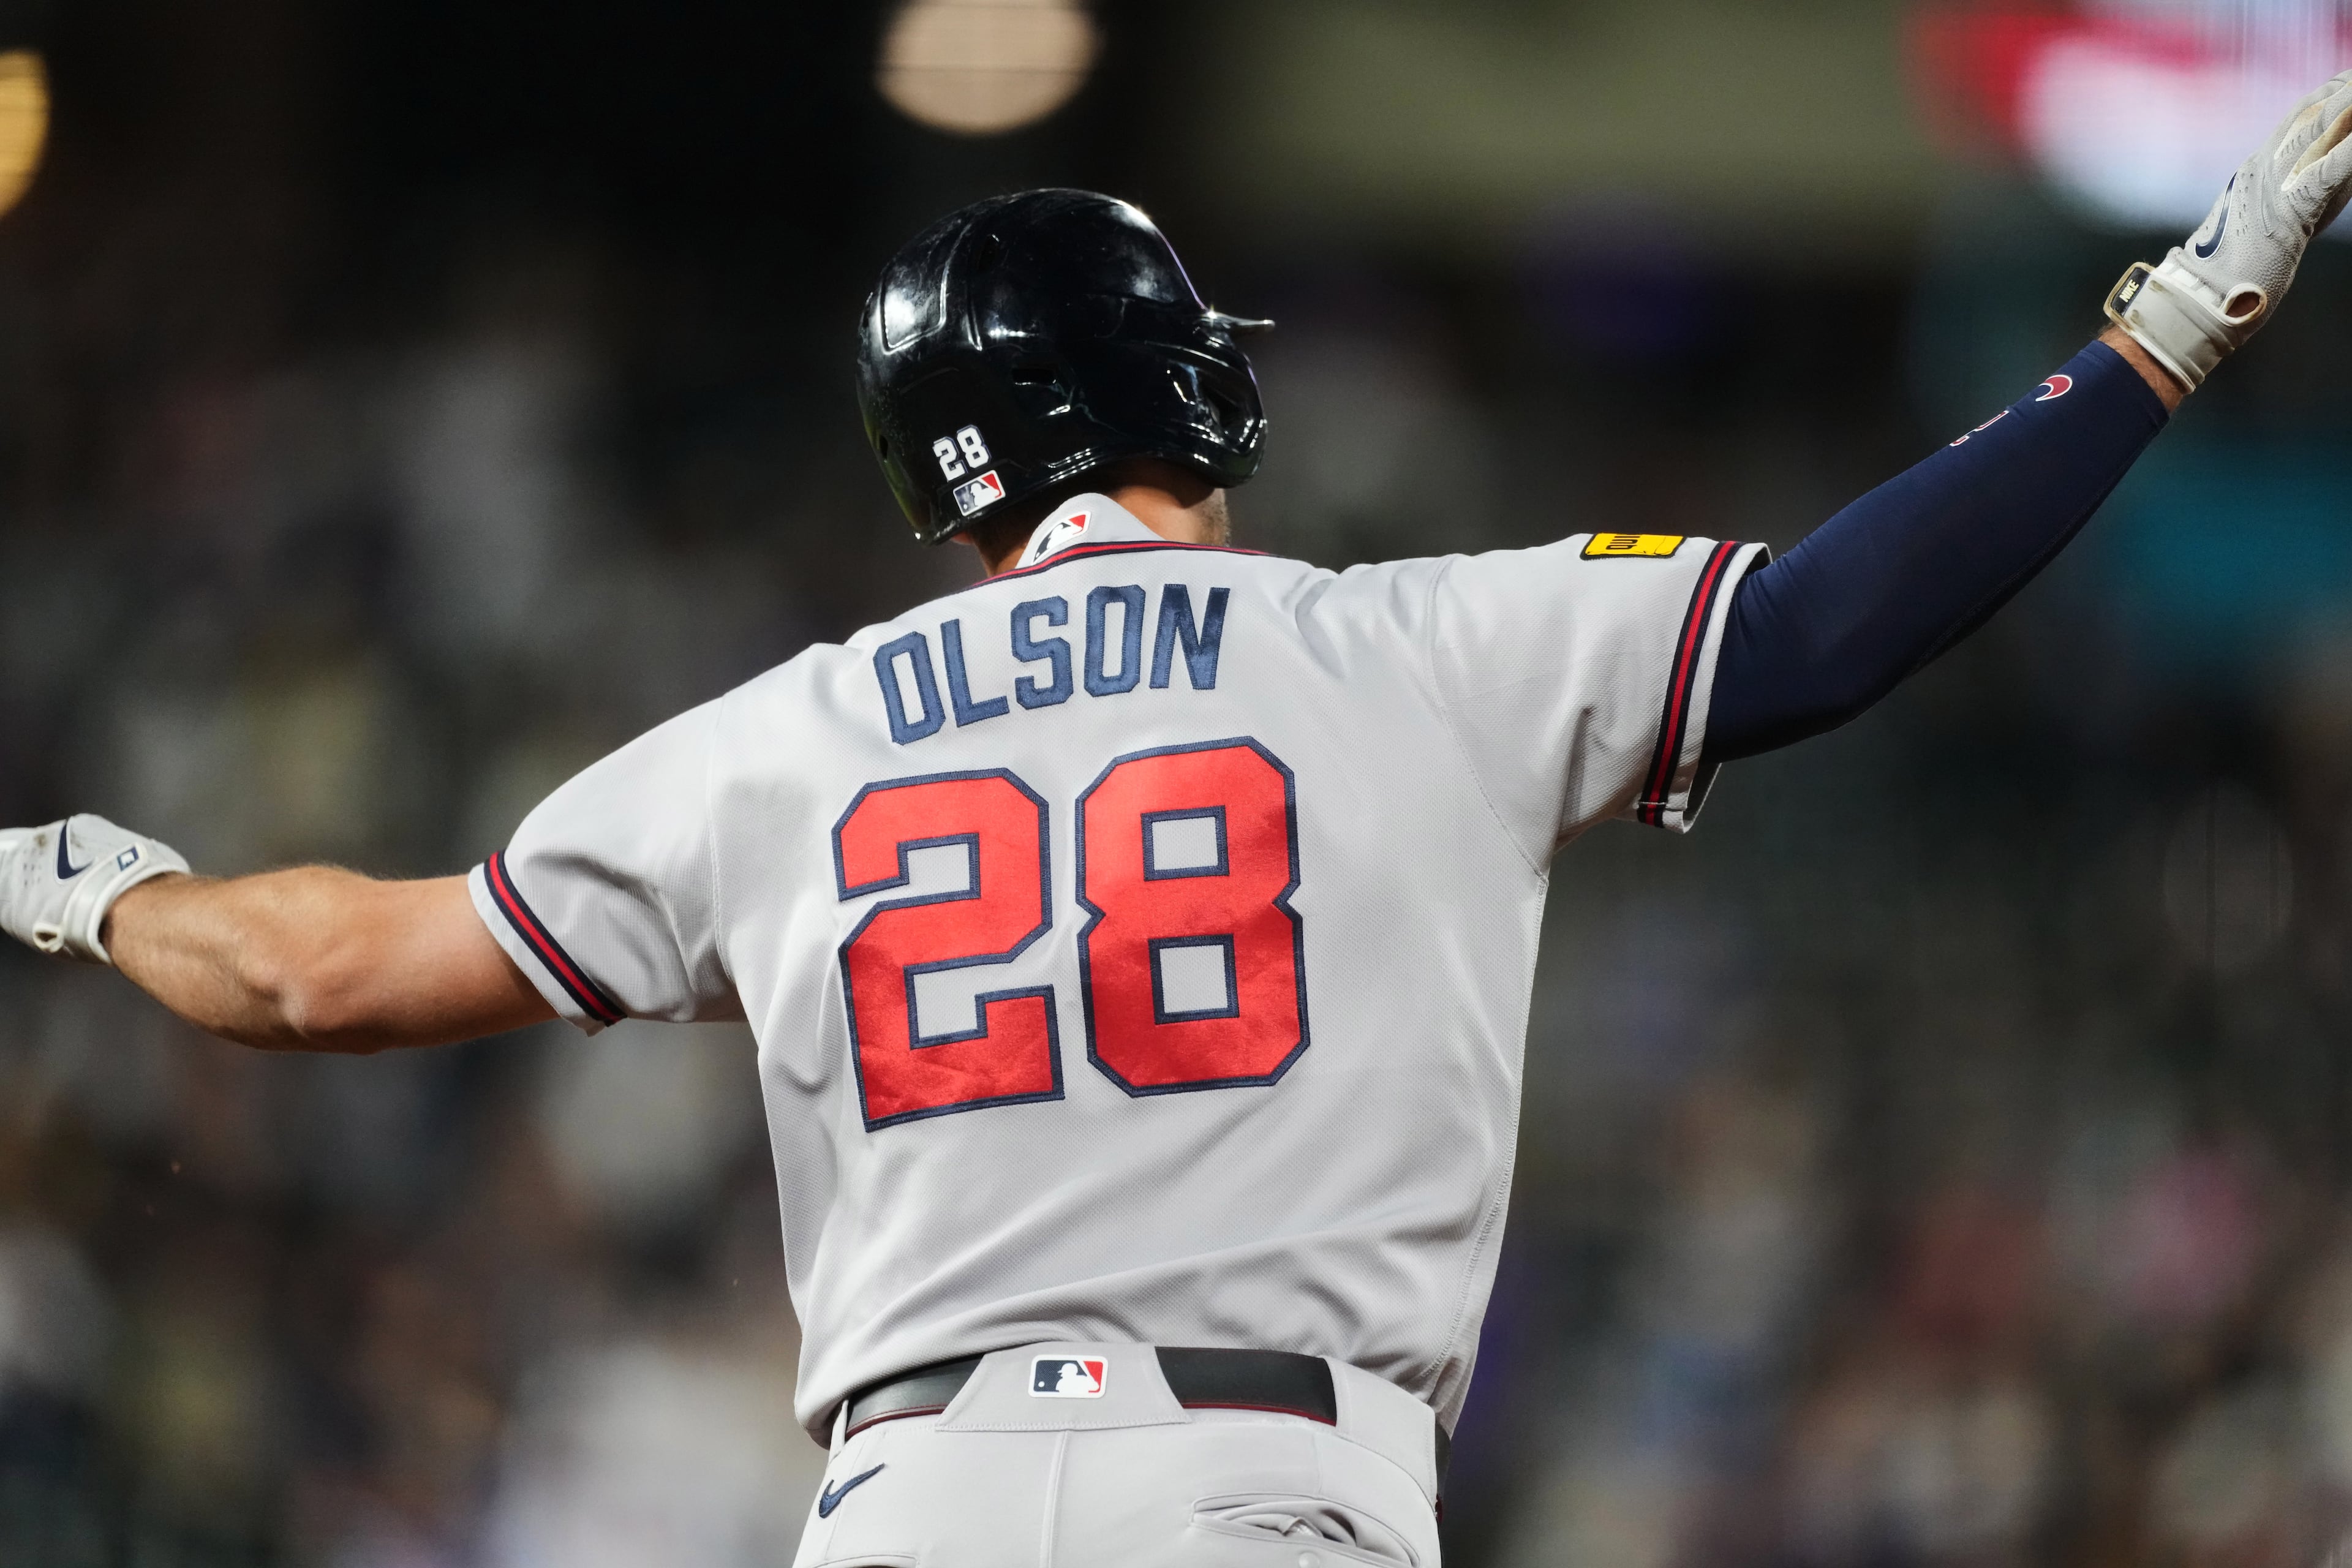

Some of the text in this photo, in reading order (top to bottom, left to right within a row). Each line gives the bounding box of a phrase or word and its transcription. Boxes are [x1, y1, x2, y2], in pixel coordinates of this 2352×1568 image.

[2119, 279, 2139, 303] NIKE
[932, 424, 991, 482] 28
[873, 584, 1230, 745] OLSON
[831, 736, 1310, 1133] 28
